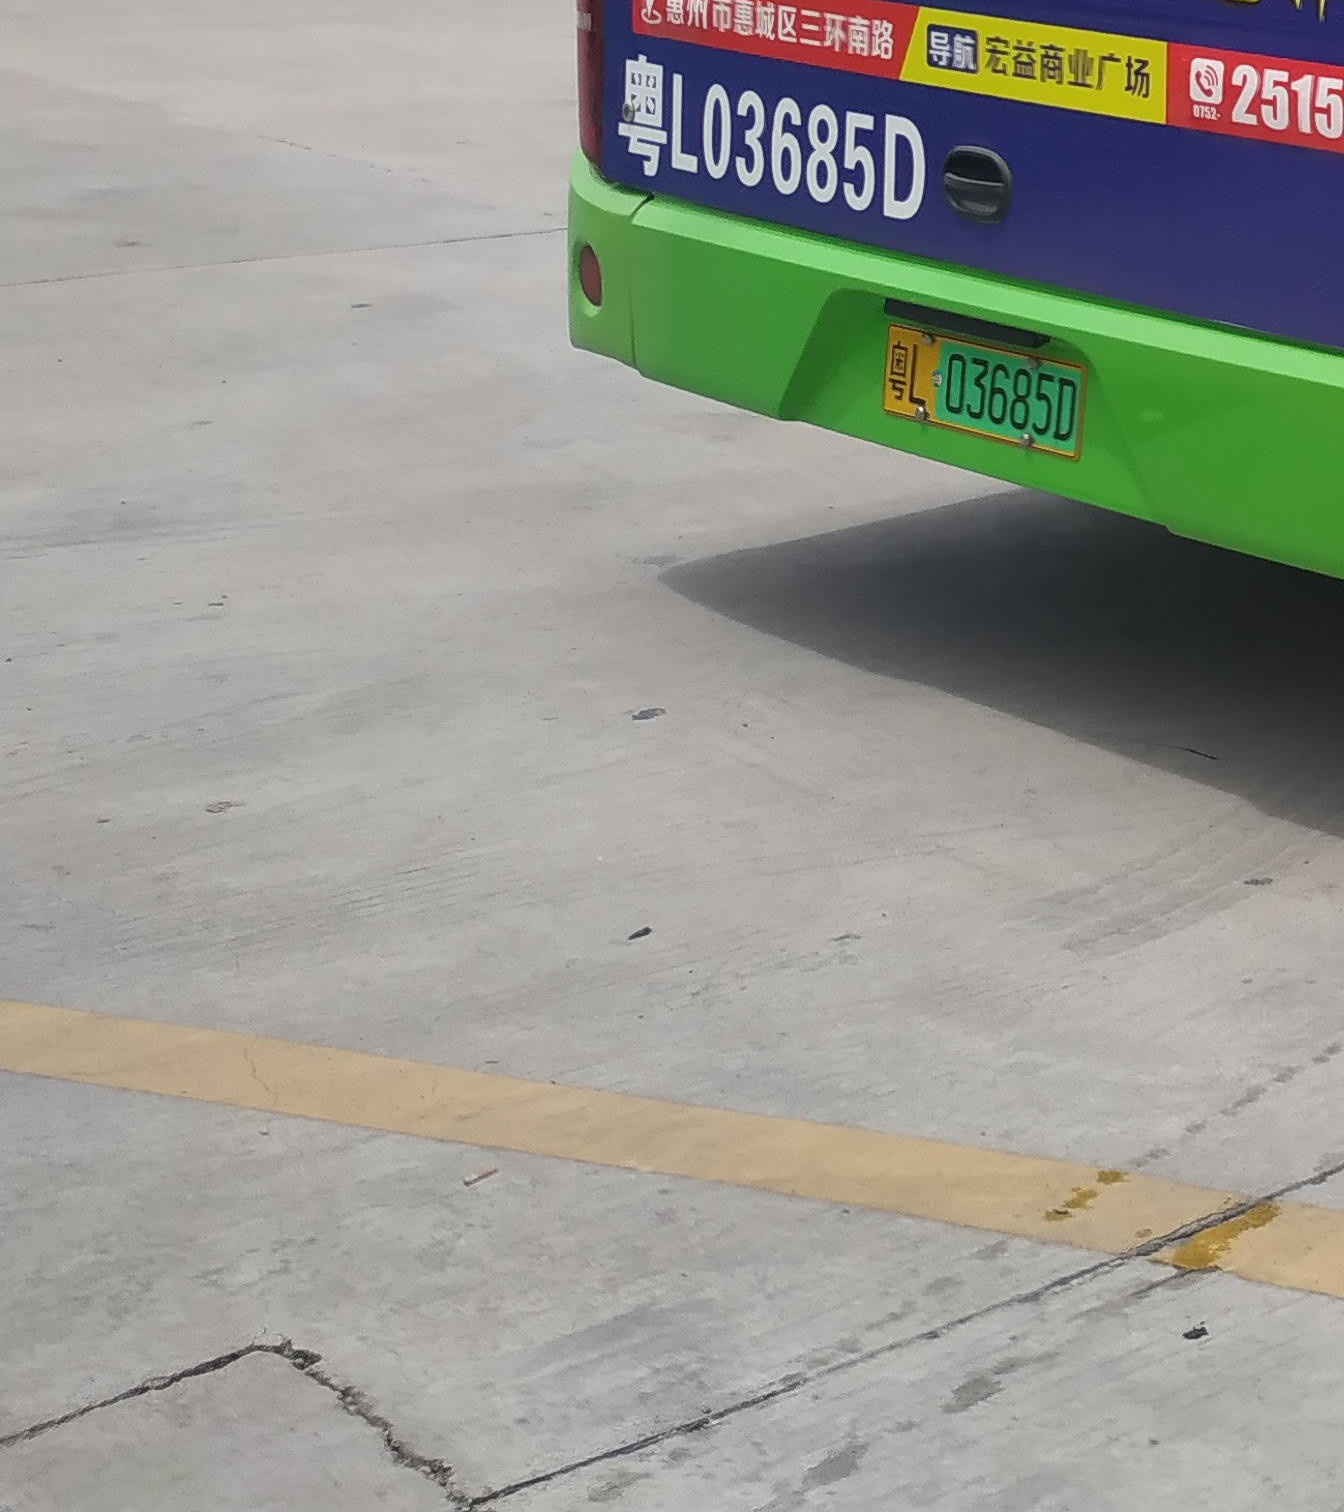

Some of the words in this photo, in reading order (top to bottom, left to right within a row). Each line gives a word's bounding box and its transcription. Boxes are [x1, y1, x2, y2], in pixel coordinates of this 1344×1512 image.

[928, 28, 978, 72] 导航
[984, 36, 1151, 100] 宏益商业广场
[618, 53, 925, 221] 粤L03685D
[1193, 104, 1221, 120] 0752-
[945, 353, 1079, 442] 03685D
